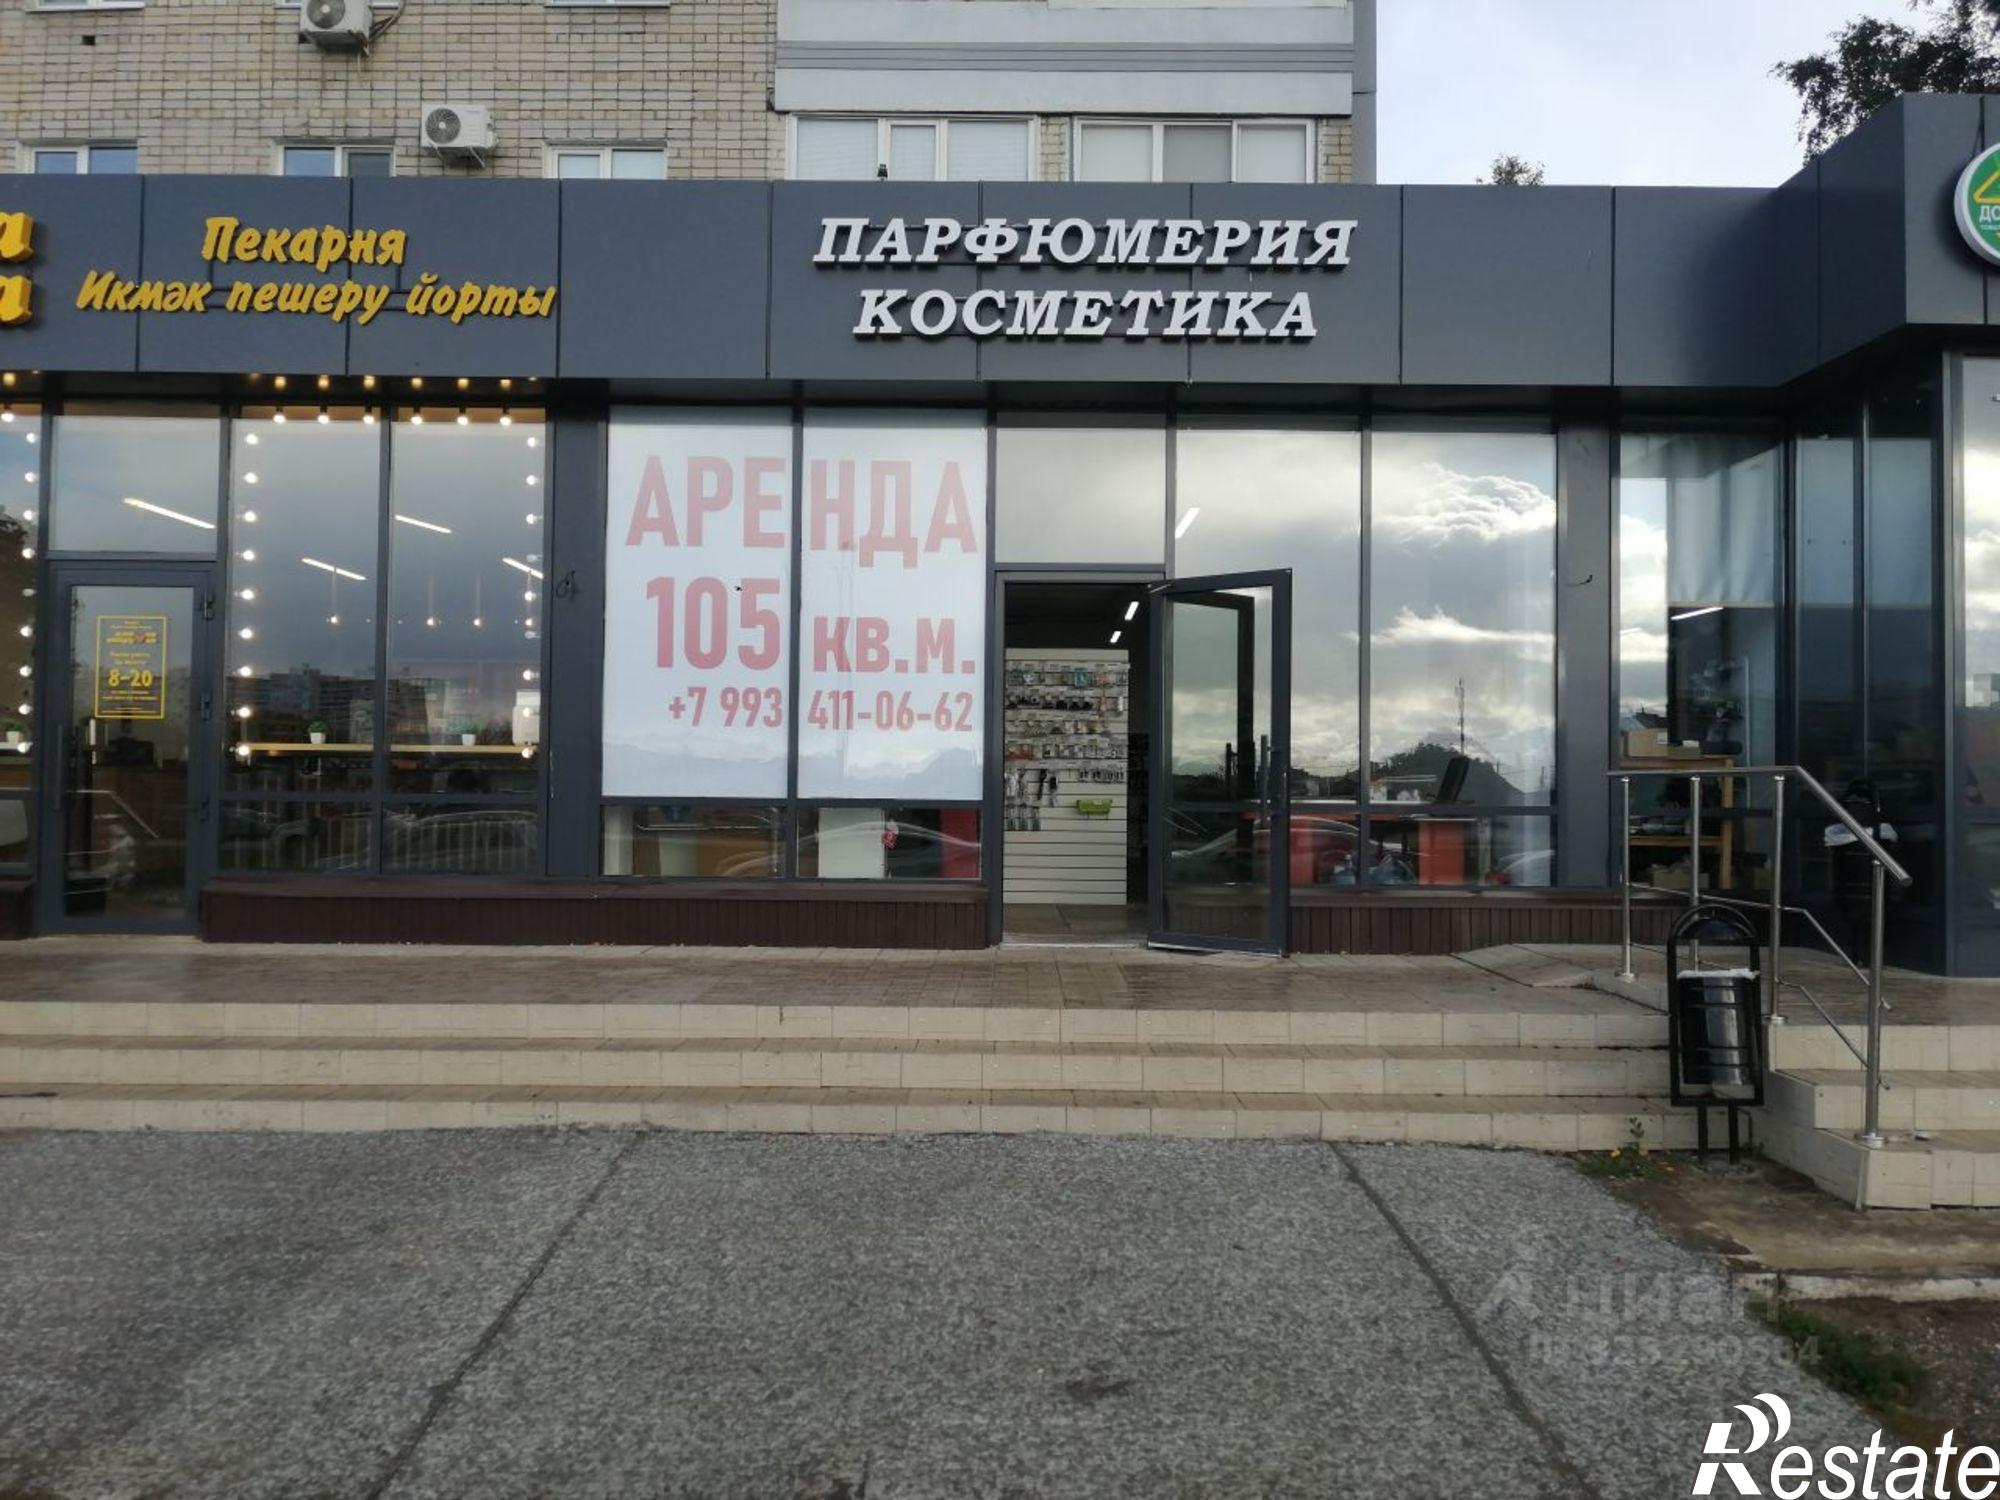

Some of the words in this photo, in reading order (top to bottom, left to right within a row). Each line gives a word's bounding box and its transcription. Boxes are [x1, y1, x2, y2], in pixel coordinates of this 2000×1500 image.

[202, 217, 406, 271] Пекарня
[813, 217, 1358, 266] ПАРФЮМЕРИЯ
[76, 271, 212, 312] Икмәк
[226, 278, 389, 324] пешеру
[405, 272, 557, 323] йорты
[853, 289, 1317, 337] КОСМЕТИКА
[626, 456, 977, 568] АРЕНДА
[646, 577, 781, 670] 105
[108, 669, 152, 687] 8-20
[669, 686, 708, 728] +7
[720, 687, 783, 728] 993
[807, 690, 973, 732] 411-06-62
